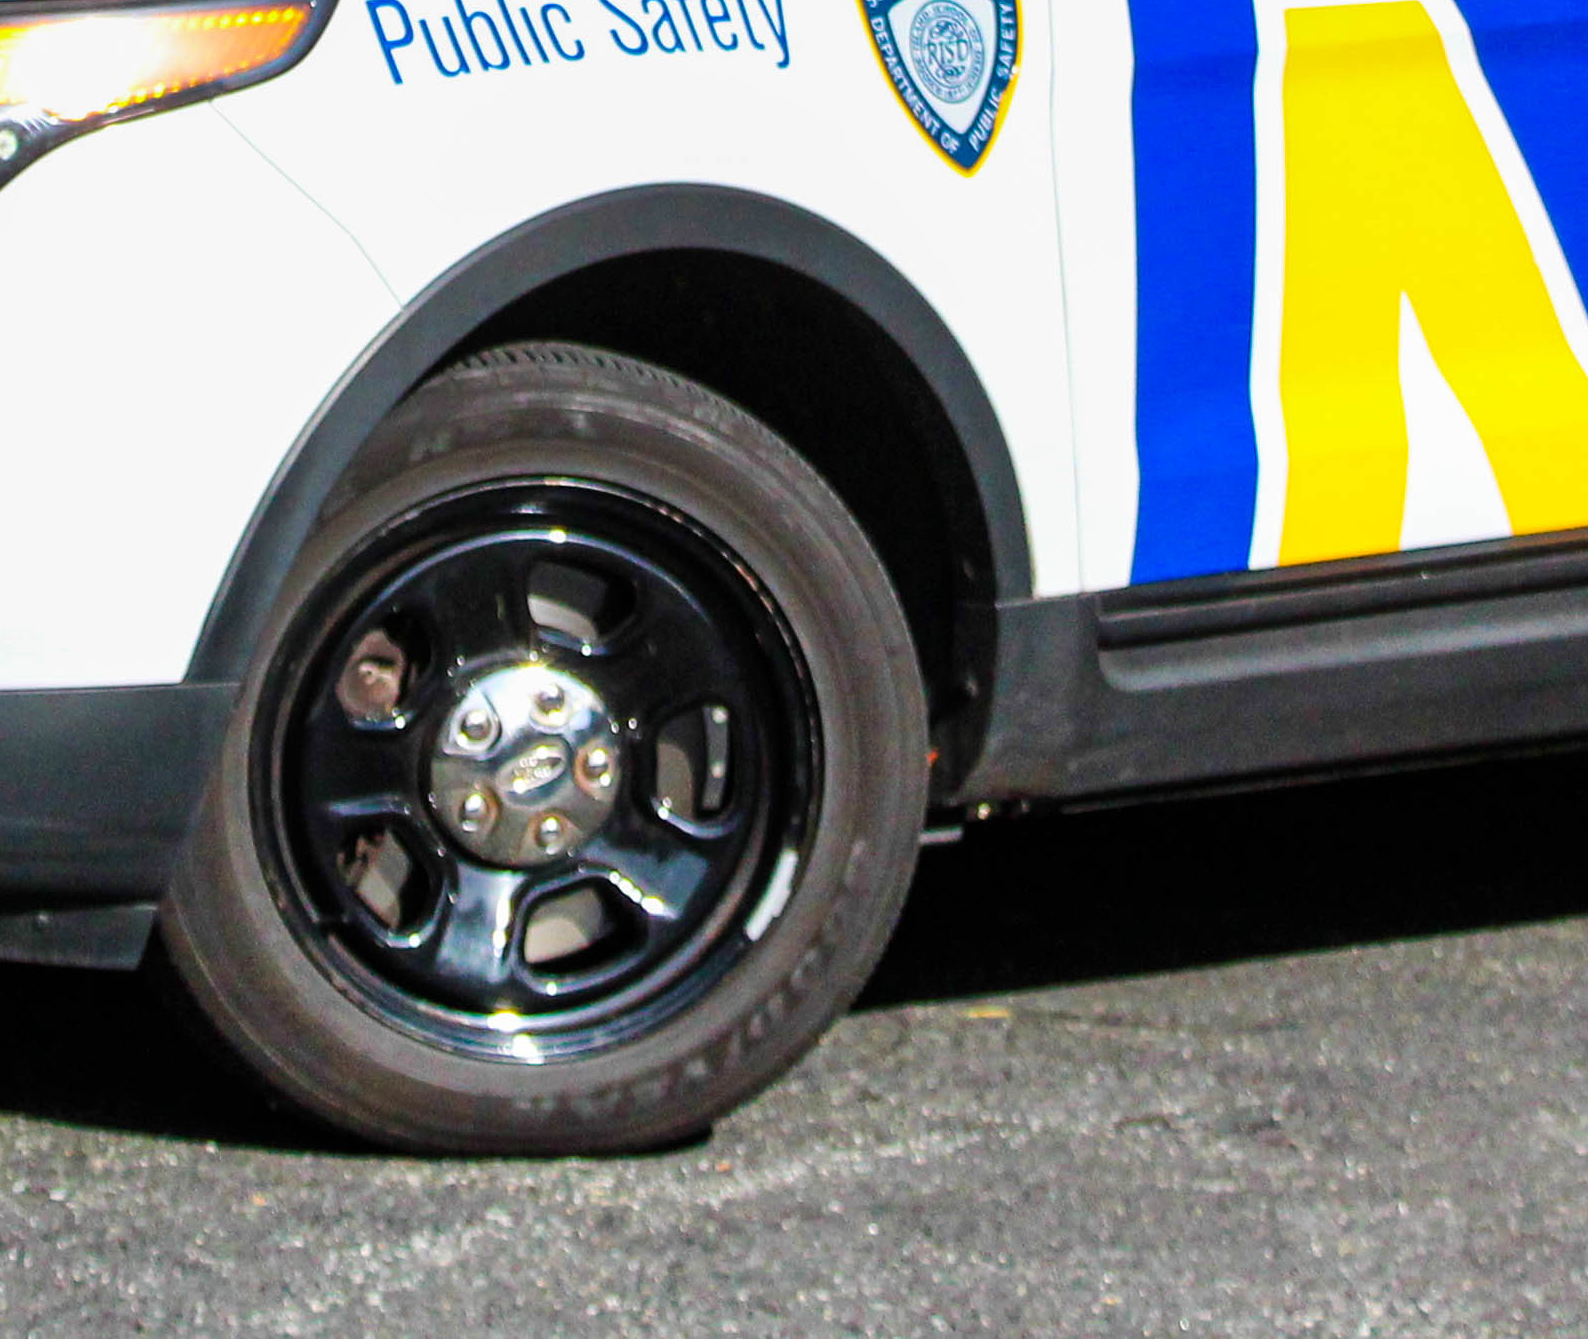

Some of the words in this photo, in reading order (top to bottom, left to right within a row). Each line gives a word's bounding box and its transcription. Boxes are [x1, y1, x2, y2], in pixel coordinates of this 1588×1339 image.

[870, 15, 941, 137] DEPARTMENT
[939, 132, 961, 154] OF
[968, 87, 1004, 152] PUBLIC
[996, 2, 1014, 81] SAFETY
